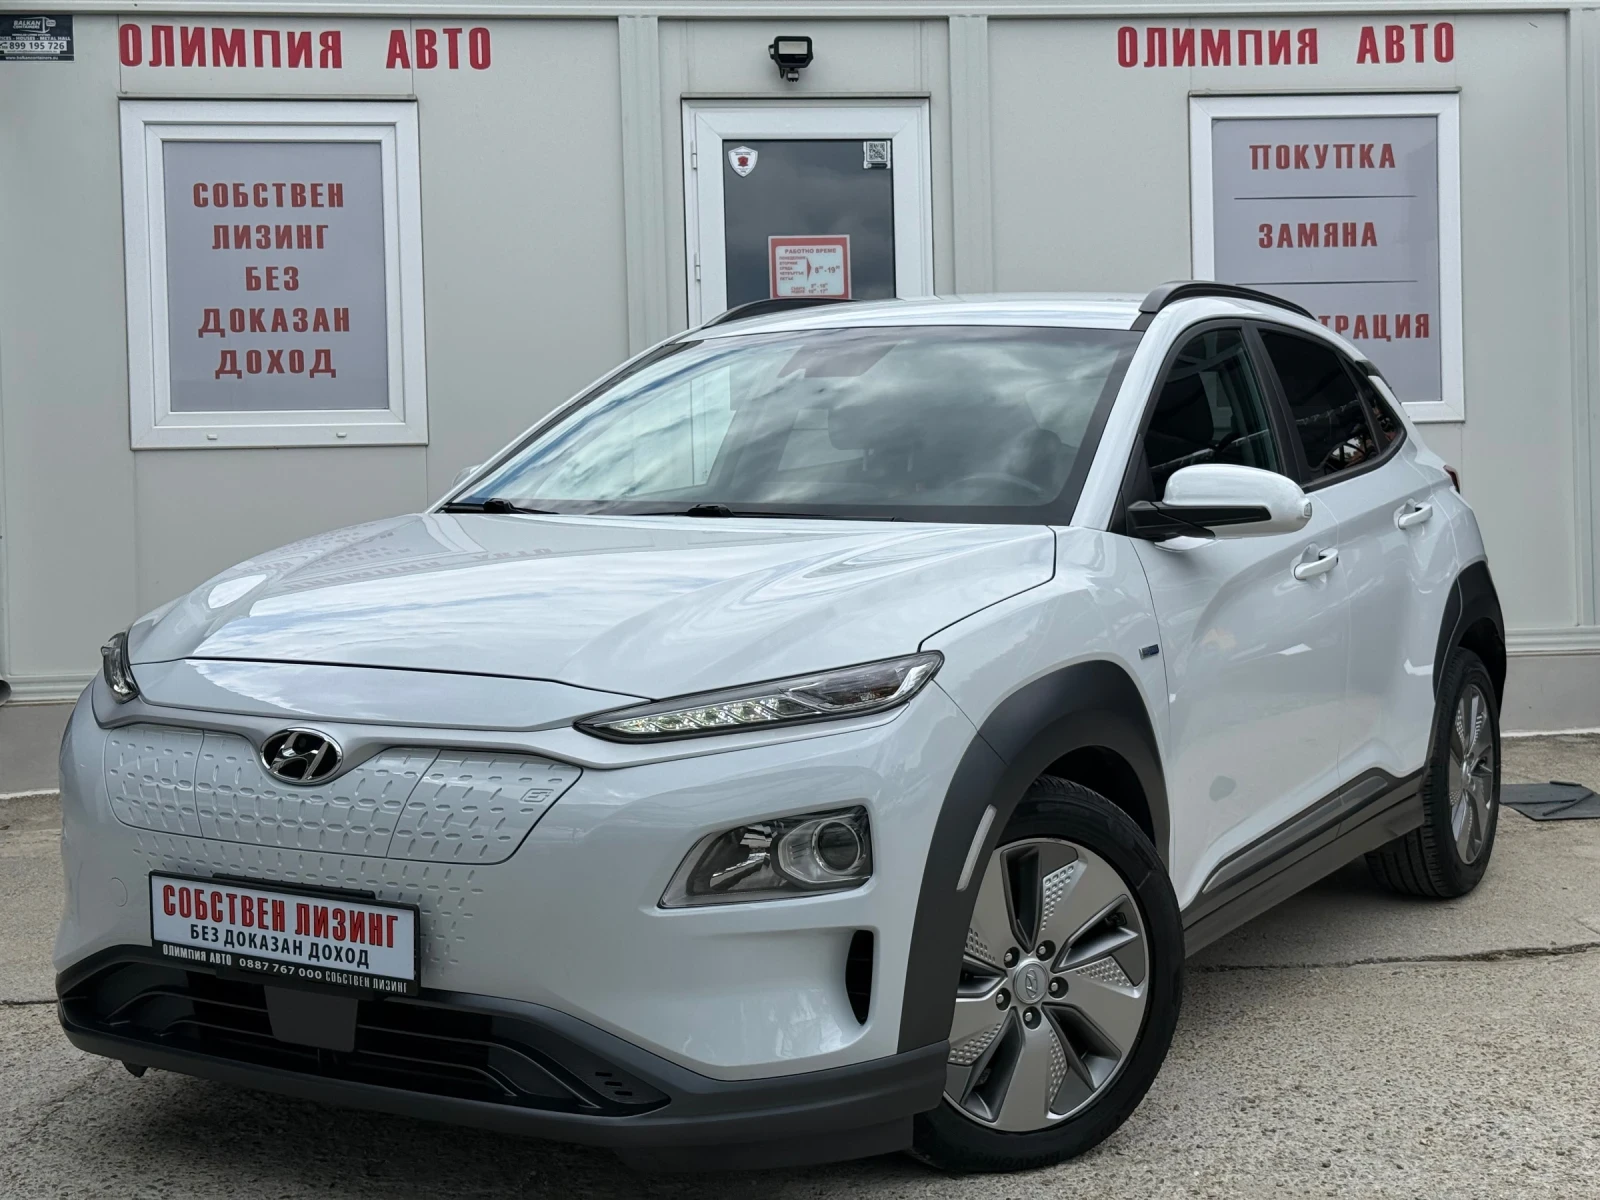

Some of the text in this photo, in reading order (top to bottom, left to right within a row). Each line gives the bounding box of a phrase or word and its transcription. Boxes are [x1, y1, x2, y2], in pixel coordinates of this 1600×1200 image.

[9, 42, 26, 50] 899
[29, 42, 45, 50] 195
[48, 42, 65, 50] 726
[119, 23, 492, 71] ОЛИМПИЯ АВТО
[1117, 22, 1455, 69] ОЛИМПИЯ АВТО
[1249, 143, 1396, 171] ПОКУПКА
[193, 182, 344, 208] СОБСТВЕН
[212, 224, 329, 250] ЛИЗИНГ
[1258, 222, 1378, 249] ЗАМЯНА
[245, 266, 299, 291] БЕЗ
[198, 307, 350, 338] ДОКАЗАН
[215, 349, 337, 379] ДОХОД
[163, 884, 398, 948] СОБСТВЕН ЛИЗИНГ
[190, 923, 369, 970] БЕЗ ДОКАЗАН ДОХОД
[163, 943, 407, 993] ОЛИМПИЯ АВТО 0887 767 000 СОБСТВЕН ЛИЗИНГ
